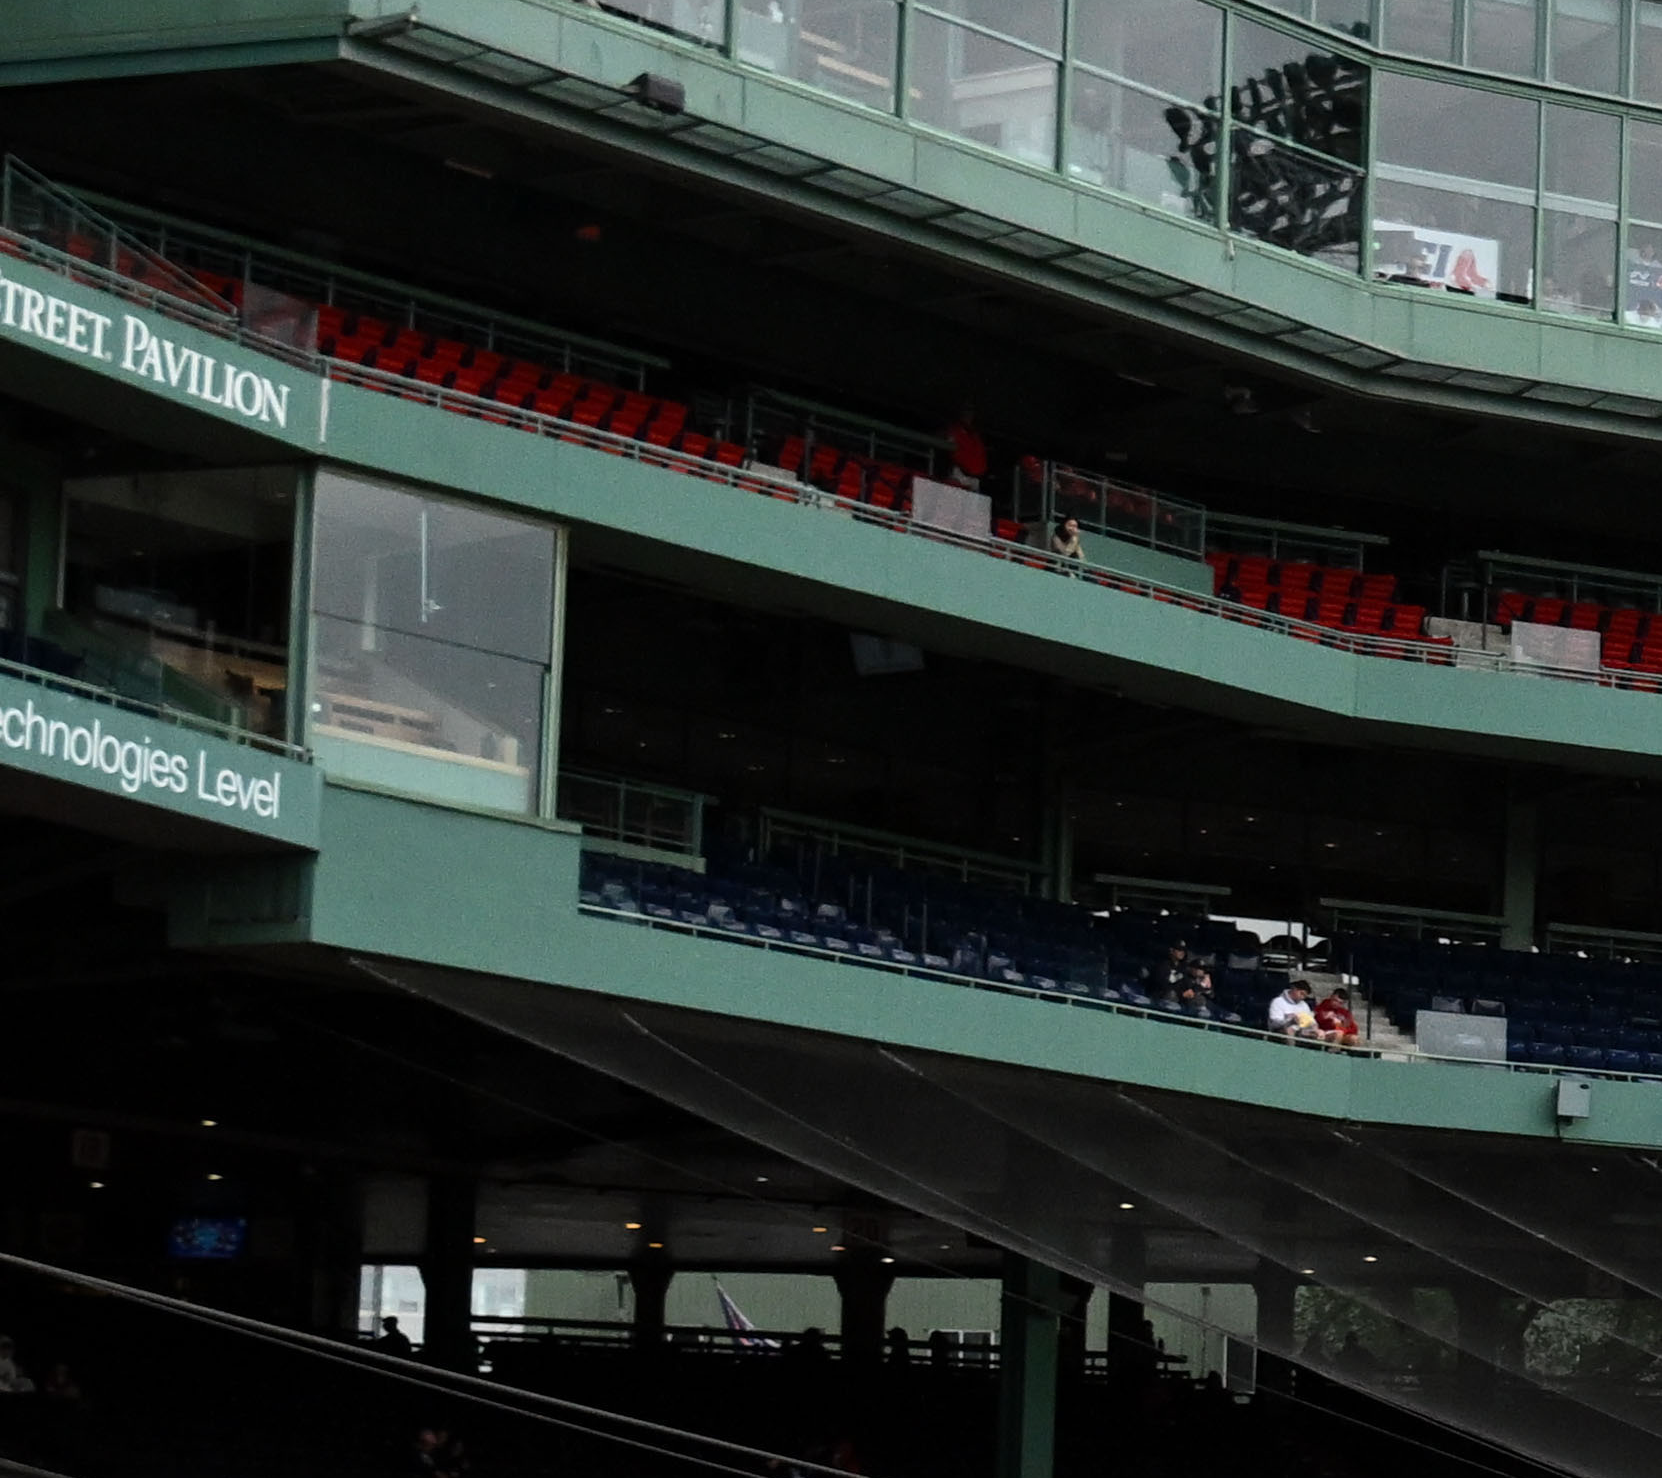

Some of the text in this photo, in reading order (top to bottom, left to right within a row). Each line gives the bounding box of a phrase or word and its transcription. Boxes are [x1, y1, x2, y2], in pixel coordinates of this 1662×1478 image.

[0, 268, 290, 429] TREET PAVILION
[0, 699, 281, 819] chnologies Level
